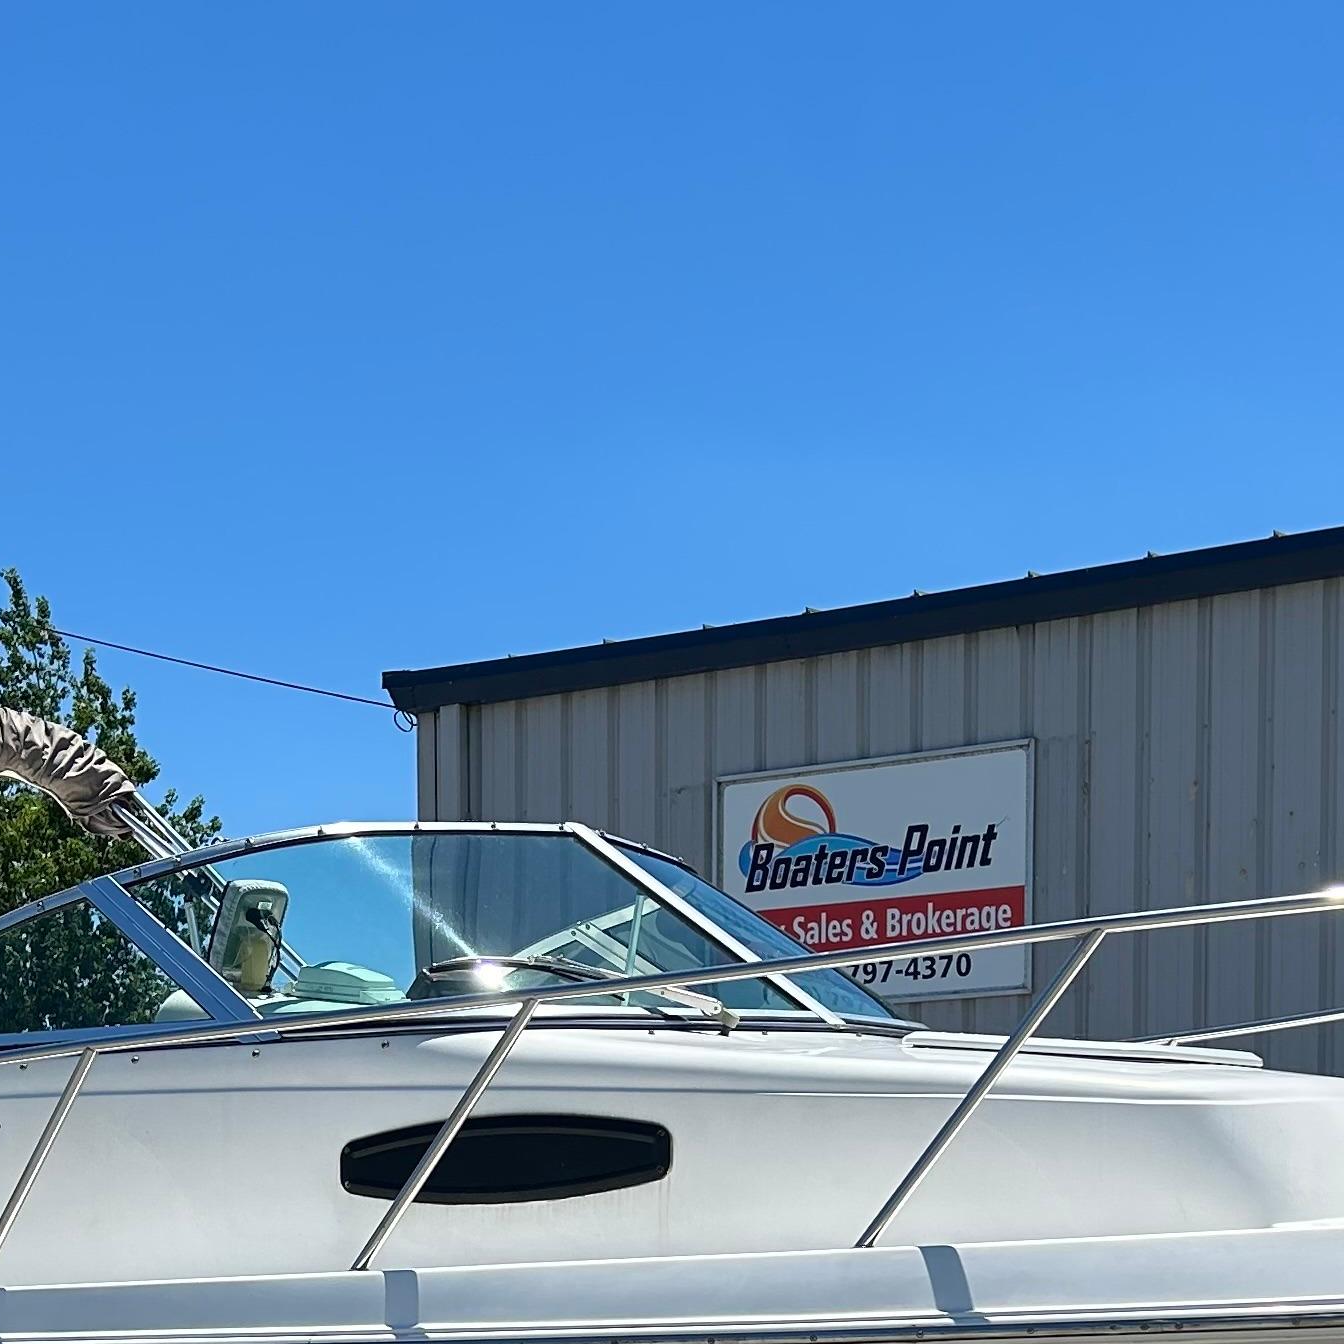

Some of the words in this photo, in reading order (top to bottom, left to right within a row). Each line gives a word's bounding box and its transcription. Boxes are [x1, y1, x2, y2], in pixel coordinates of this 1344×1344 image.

[745, 843, 889, 893] Boaters
[898, 824, 998, 876] Point
[793, 912, 853, 945] Sales
[860, 909, 878, 940] &
[886, 902, 1012, 937] Brokerage
